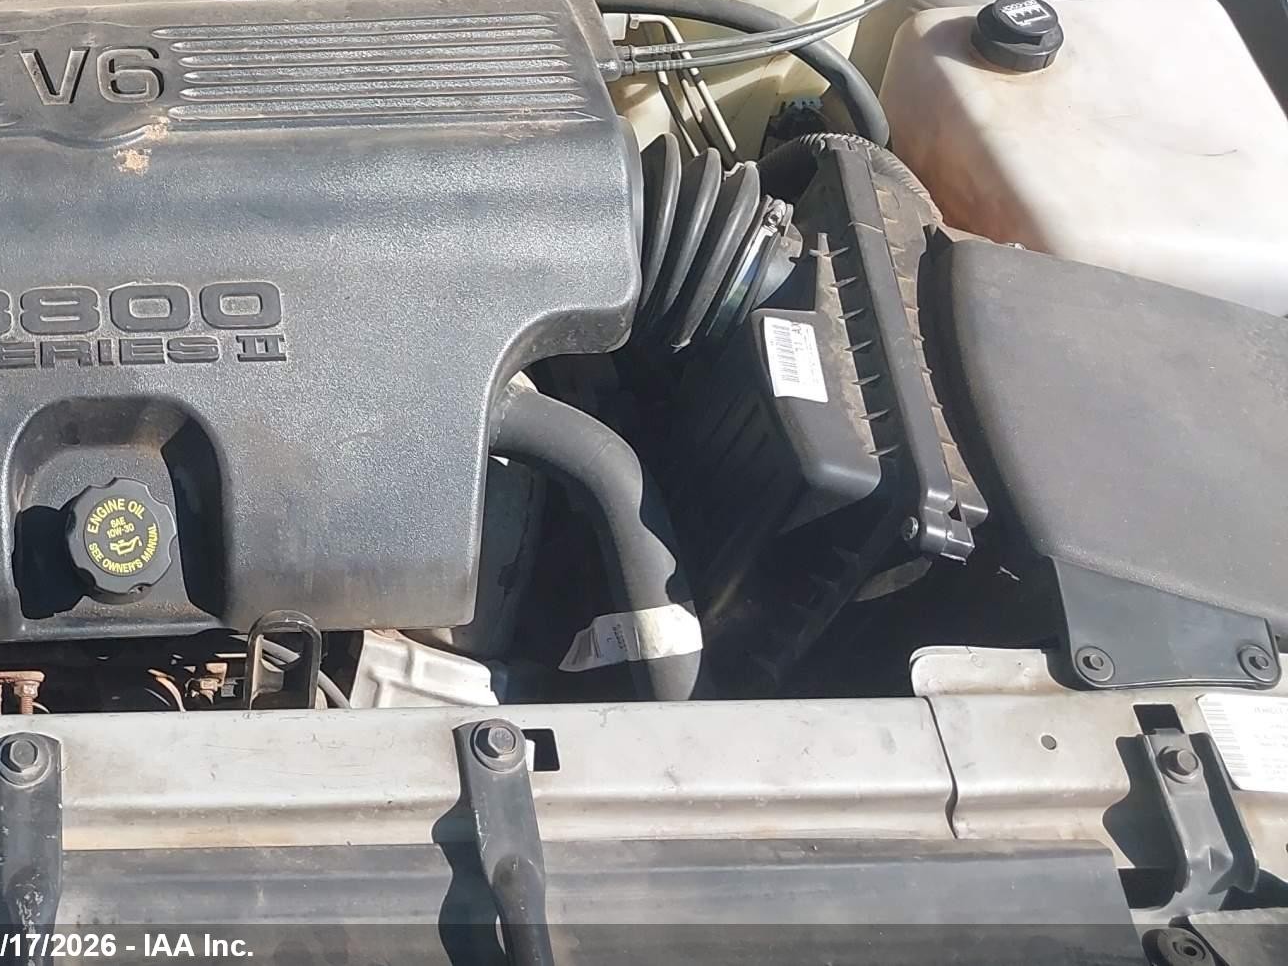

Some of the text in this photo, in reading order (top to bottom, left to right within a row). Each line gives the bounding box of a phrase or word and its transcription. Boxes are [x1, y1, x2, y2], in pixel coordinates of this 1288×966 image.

[19, 46, 164, 105] V6
[236, 334, 287, 363] II
[87, 498, 145, 534] ENGINE OIL
[106, 523, 135, 538] 10W-30
[110, 516, 126, 528] SAE
[89, 522, 158, 573] SEE OWNER'S MANUAL
